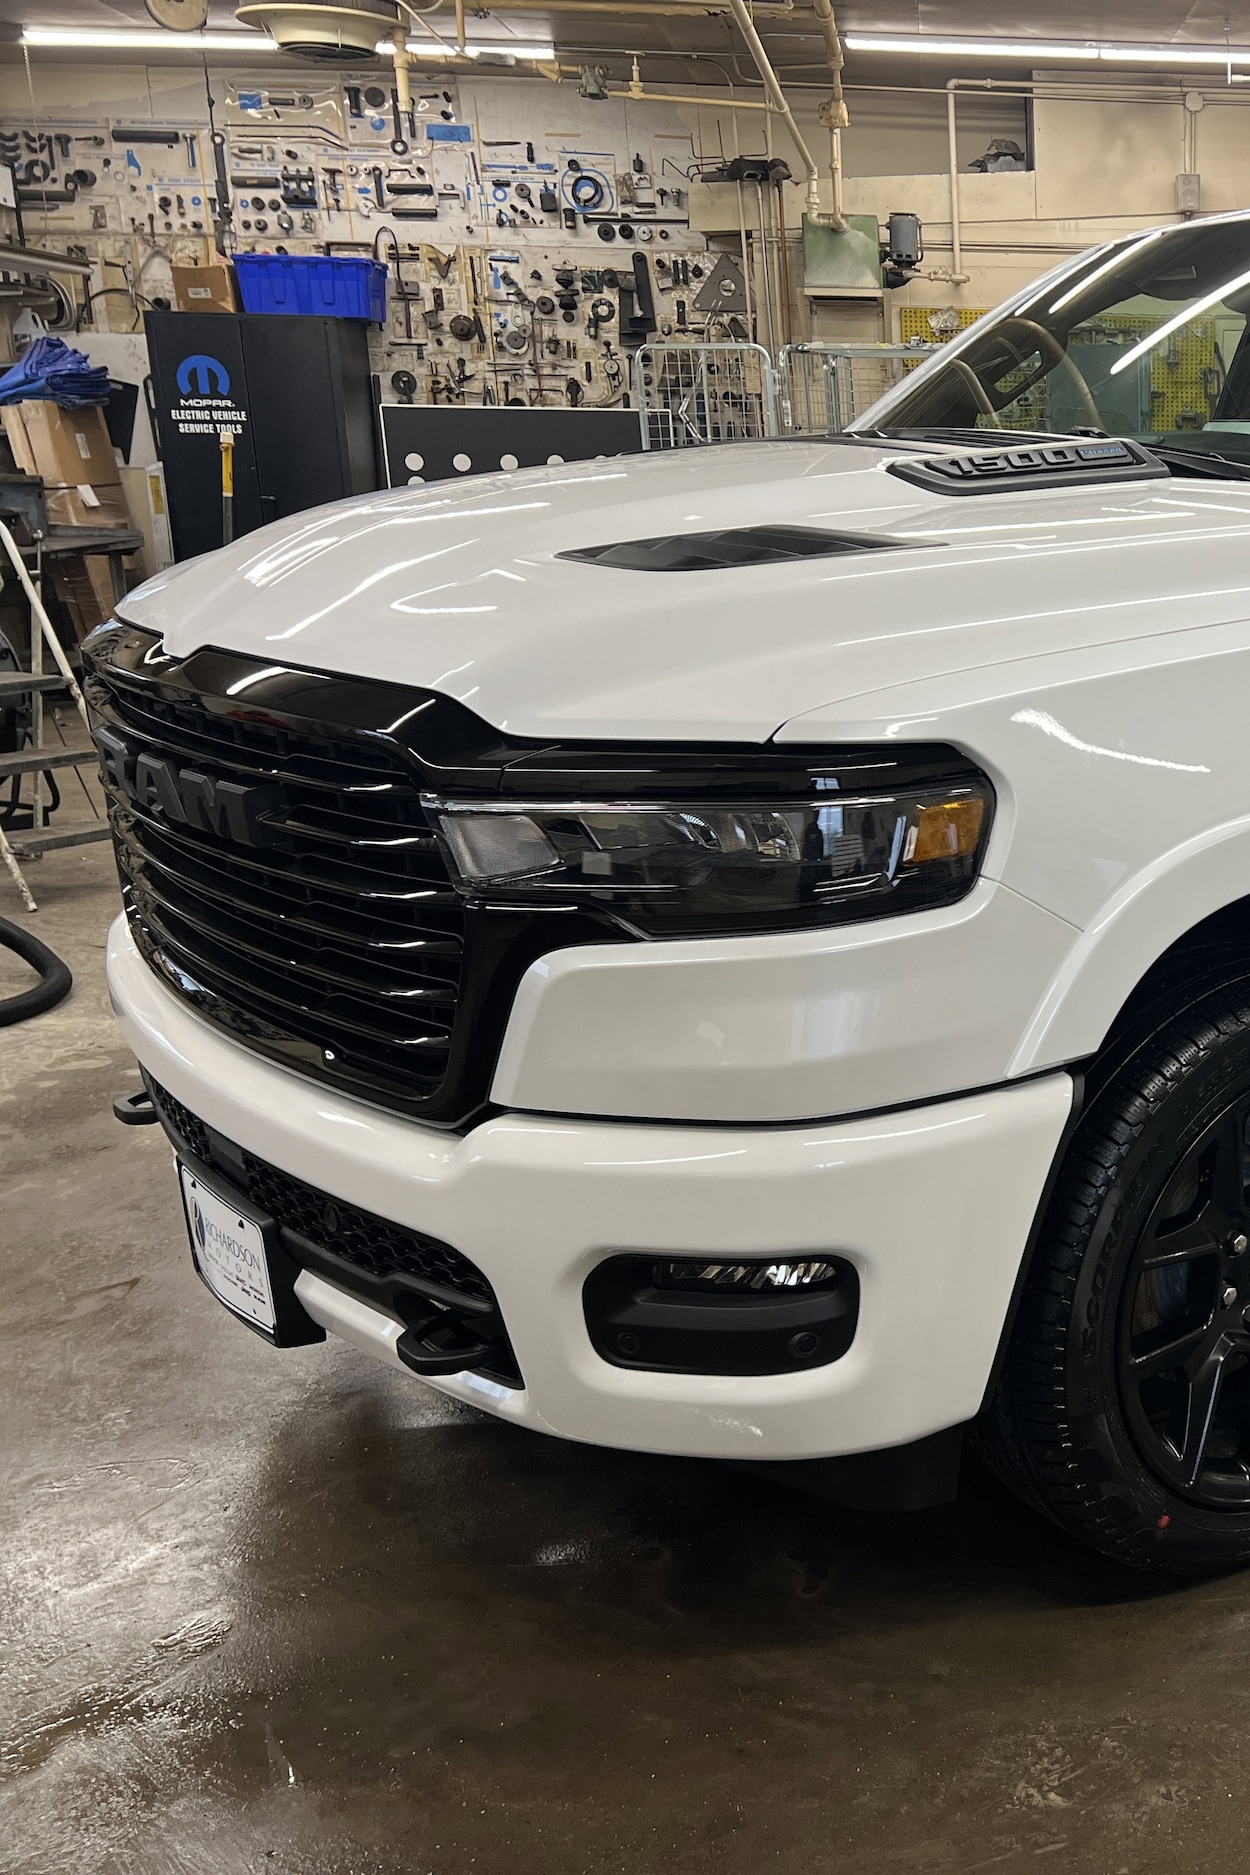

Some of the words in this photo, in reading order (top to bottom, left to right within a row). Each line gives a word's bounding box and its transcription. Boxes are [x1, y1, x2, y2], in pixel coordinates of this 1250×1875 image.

[180, 399, 233, 407] MOPAR
[171, 410, 210, 420] ELECTRIC
[212, 411, 247, 421] VEHICLE
[179, 423, 214, 434] SERVICE
[216, 424, 242, 434] TOOLS
[950, 449, 1076, 476] 1500
[92, 726, 258, 848] RAM
[205, 1217, 261, 1271] RICHARDSON
